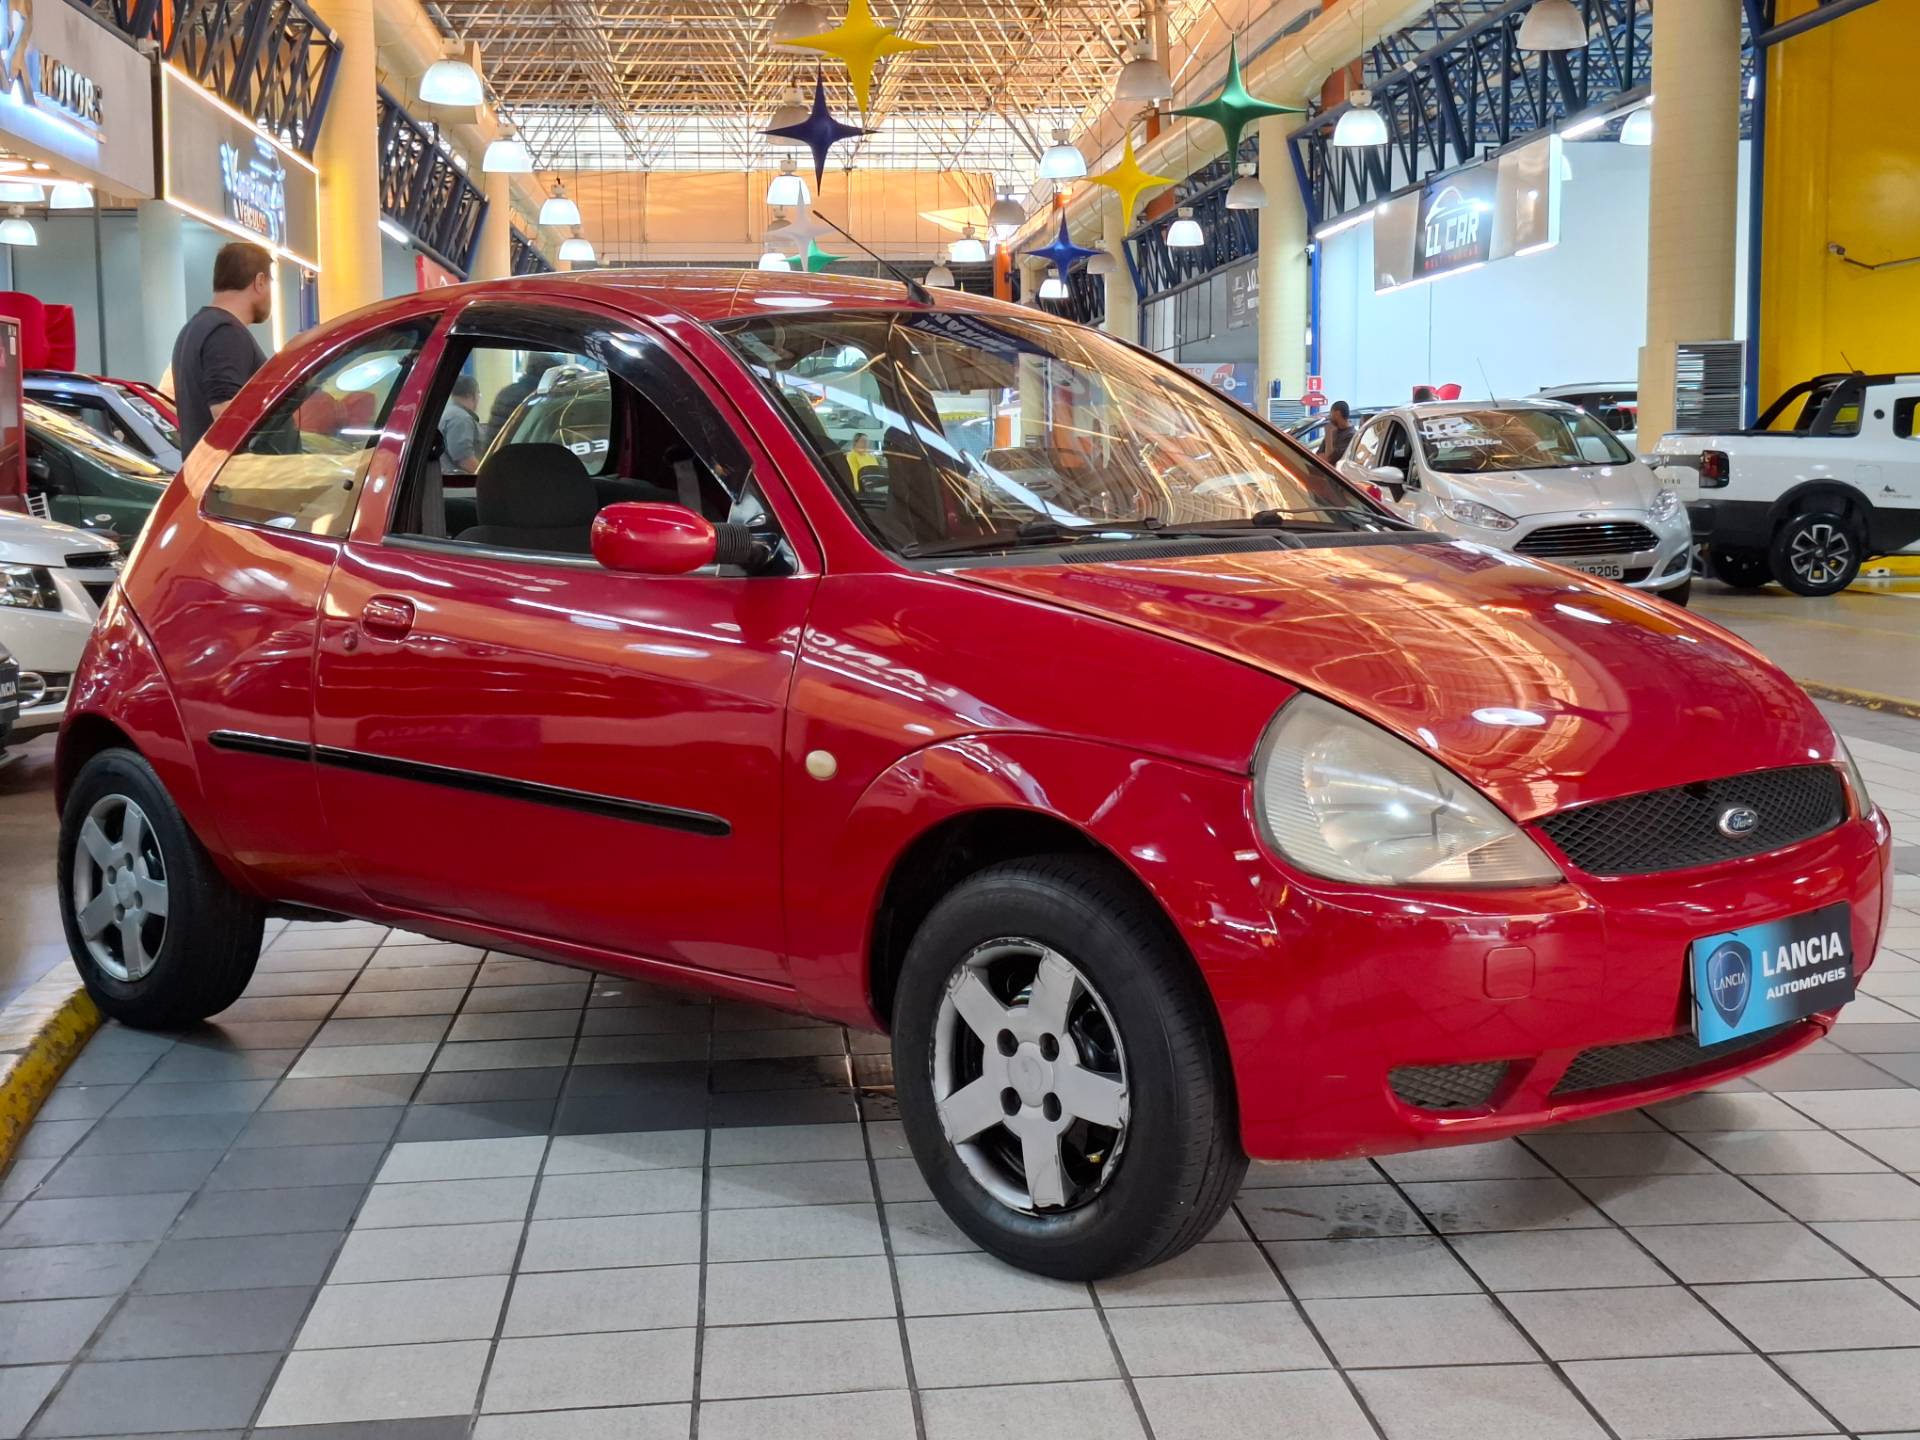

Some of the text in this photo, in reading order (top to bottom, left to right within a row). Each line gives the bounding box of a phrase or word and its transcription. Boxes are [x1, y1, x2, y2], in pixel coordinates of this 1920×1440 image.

[1445, 211, 1480, 251] CAR
[1762, 931, 1844, 977] LANCIA
[1713, 971, 1746, 991] LANCIA
[1766, 967, 1847, 1000] AUTOMÓVEIS
